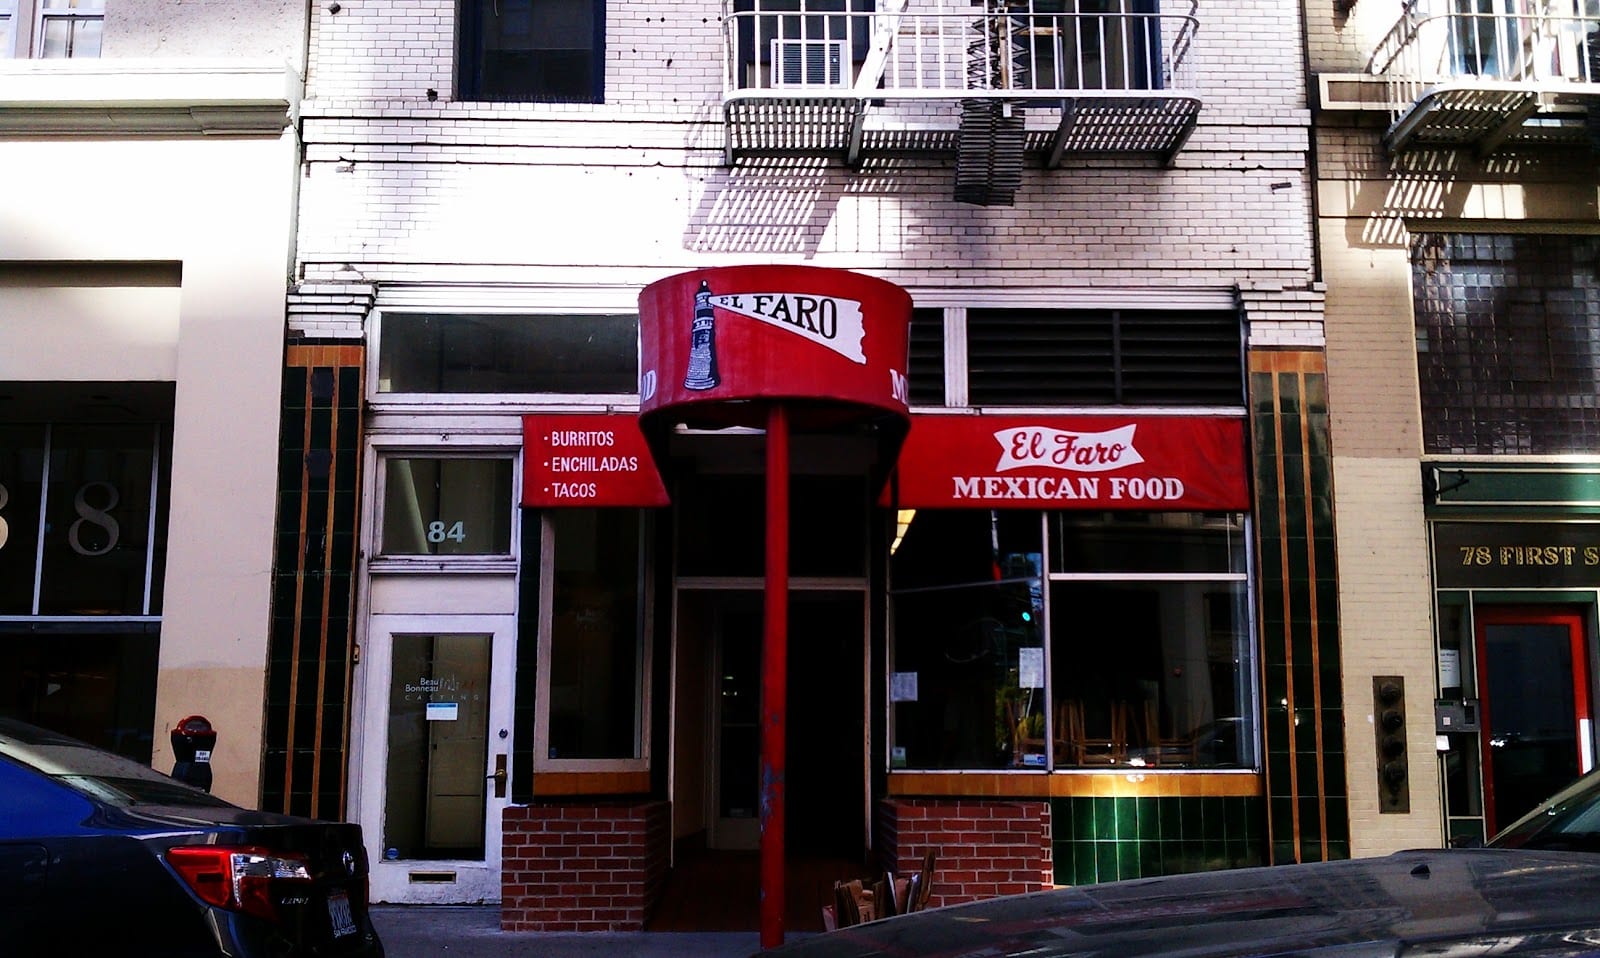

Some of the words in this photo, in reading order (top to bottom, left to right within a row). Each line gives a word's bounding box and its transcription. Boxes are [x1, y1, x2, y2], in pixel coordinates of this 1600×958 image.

[720, 296, 743, 309] EL
[753, 294, 837, 339] FARO
[551, 430, 614, 447] BURRITOS
[1011, 432, 1046, 460] El
[1052, 434, 1127, 465] Faro
[551, 456, 638, 472] ENCHILADAS
[551, 482, 597, 498] TACOS
[952, 476, 1100, 500] MEXICAN
[1109, 477, 1185, 500] FOOD
[427, 520, 466, 543] 84
[1460, 546, 1492, 565] 78
[1499, 546, 1576, 565] FIRST
[1583, 546, 1600, 565] S
[405, 684, 439, 693] Bonneau
[420, 677, 439, 686] Beau
